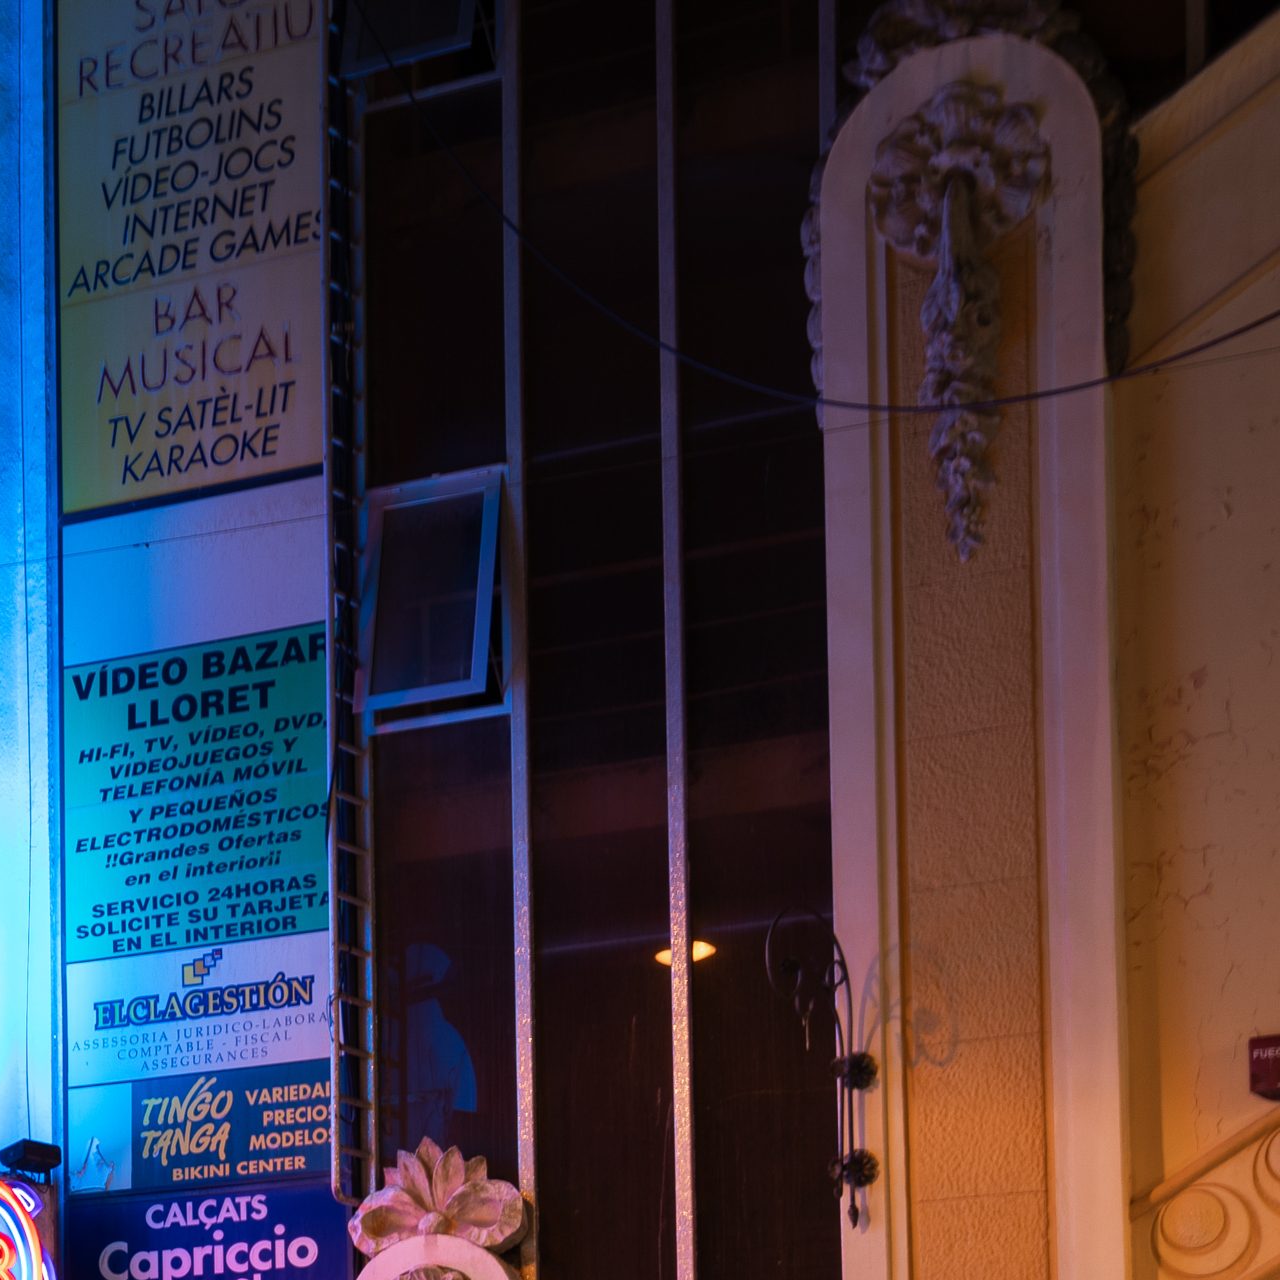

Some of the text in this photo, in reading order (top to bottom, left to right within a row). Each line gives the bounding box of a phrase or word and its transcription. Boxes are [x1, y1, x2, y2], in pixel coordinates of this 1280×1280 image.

[138, 66, 255, 124] BILLARS
[111, 98, 283, 171] FUTBOLINS
[101, 136, 296, 211] VÍDEO-JOCS
[122, 180, 275, 246] INTERNET
[67, 243, 200, 298] ARCADE
[154, 282, 239, 337] BAR
[97, 320, 297, 405] MUSICAL
[108, 413, 147, 449] TV
[121, 424, 280, 486] KARAOKE
[72, 632, 327, 702] VÍDEO BAZAR
[127, 680, 276, 732] LLORET
[78, 742, 135, 765] HI-FI,
[144, 735, 179, 754] TV,
[188, 721, 265, 747] VÍDEO,
[109, 737, 300, 780] VIDEOJUEGOS Y
[99, 756, 308, 803] TELEFONÍA MÓVIL
[75, 801, 329, 854] ELECTRODOMÉSTICOS
[129, 787, 278, 824] Y PEQUEÑOS
[217, 829, 302, 851] Ofertas
[91, 873, 318, 919] SERVICIO 24HORAS
[124, 872, 152, 887] en
[158, 865, 178, 882] el
[76, 890, 330, 940] SOLICITE SU TARJETA
[112, 915, 297, 954] EN EL INTERIOR
[72, 1031, 169, 1052] ASSESSORIA
[117, 1040, 214, 1060] COMPTABLE
[235, 1031, 292, 1048] FISCAL
[140, 1046, 269, 1072] ASSEGURANCES
[142, 1076, 233, 1126] TINGO
[142, 1121, 231, 1166] TANGA
[172, 1156, 306, 1182] BIKINI CENTER
[145, 1194, 268, 1231] CALÇATS
